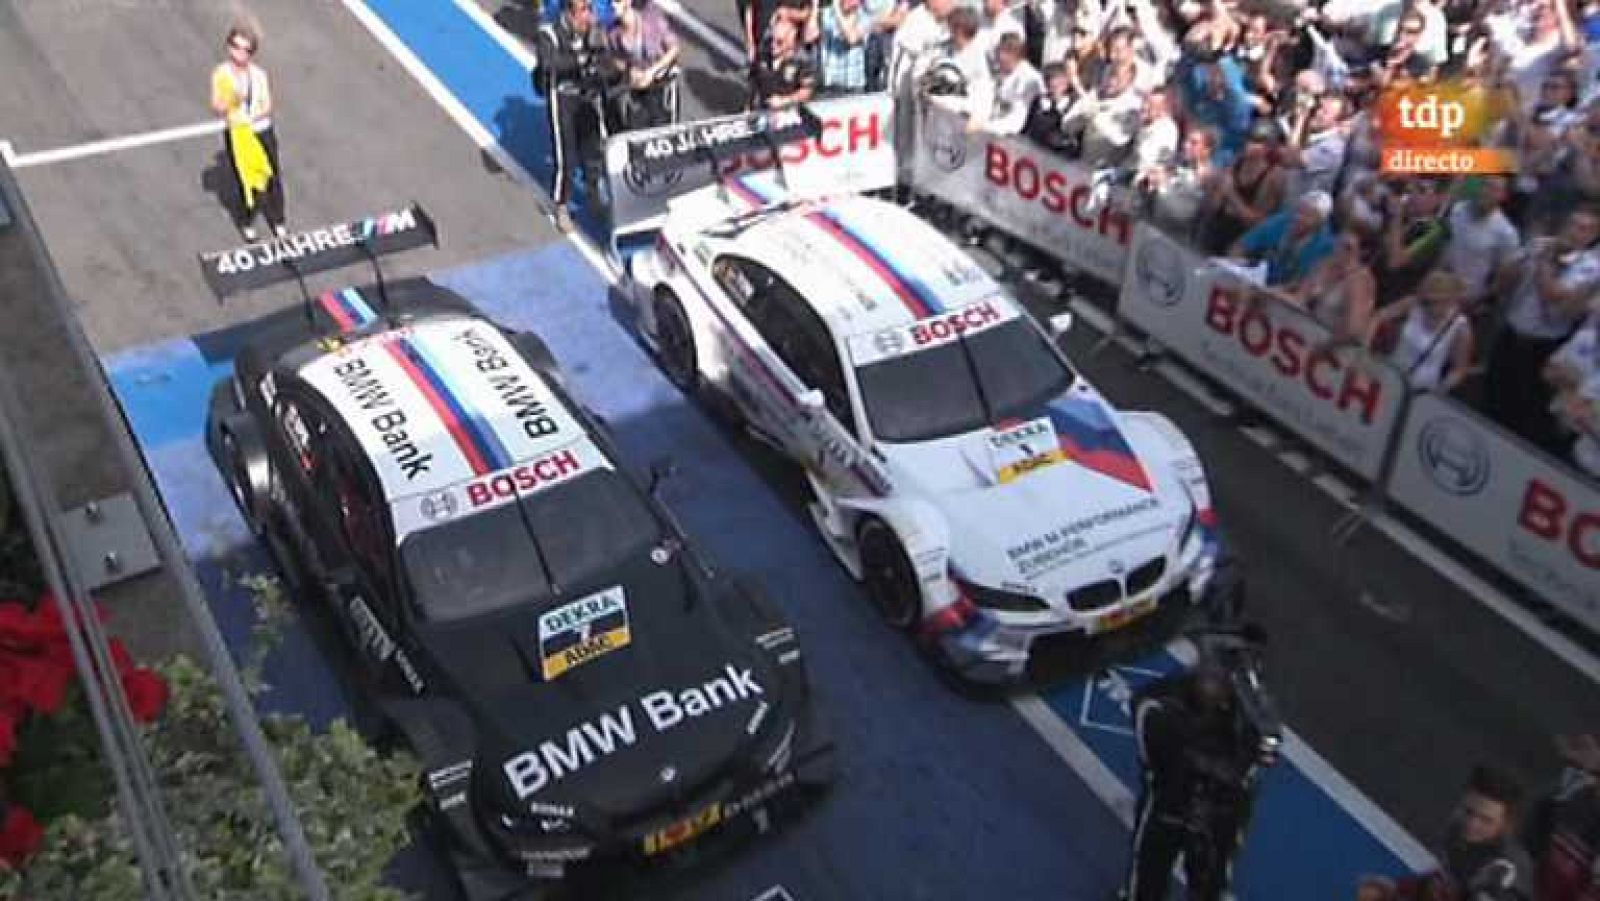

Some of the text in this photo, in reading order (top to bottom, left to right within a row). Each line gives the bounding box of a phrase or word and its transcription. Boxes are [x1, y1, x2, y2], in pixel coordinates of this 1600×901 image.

[984, 142, 1132, 245] BOSCH
[217, 251, 254, 274] 40
[258, 223, 354, 266] JAHRE
[912, 300, 1001, 345] BOSCH
[1206, 284, 1382, 426] BOSCH
[334, 358, 433, 480] BMW Bank
[488, 374, 559, 438] BMW
[467, 449, 580, 507] BOSCH
[545, 596, 618, 631] DEKRA
[503, 704, 636, 798] BMW
[640, 663, 765, 732] Bank
